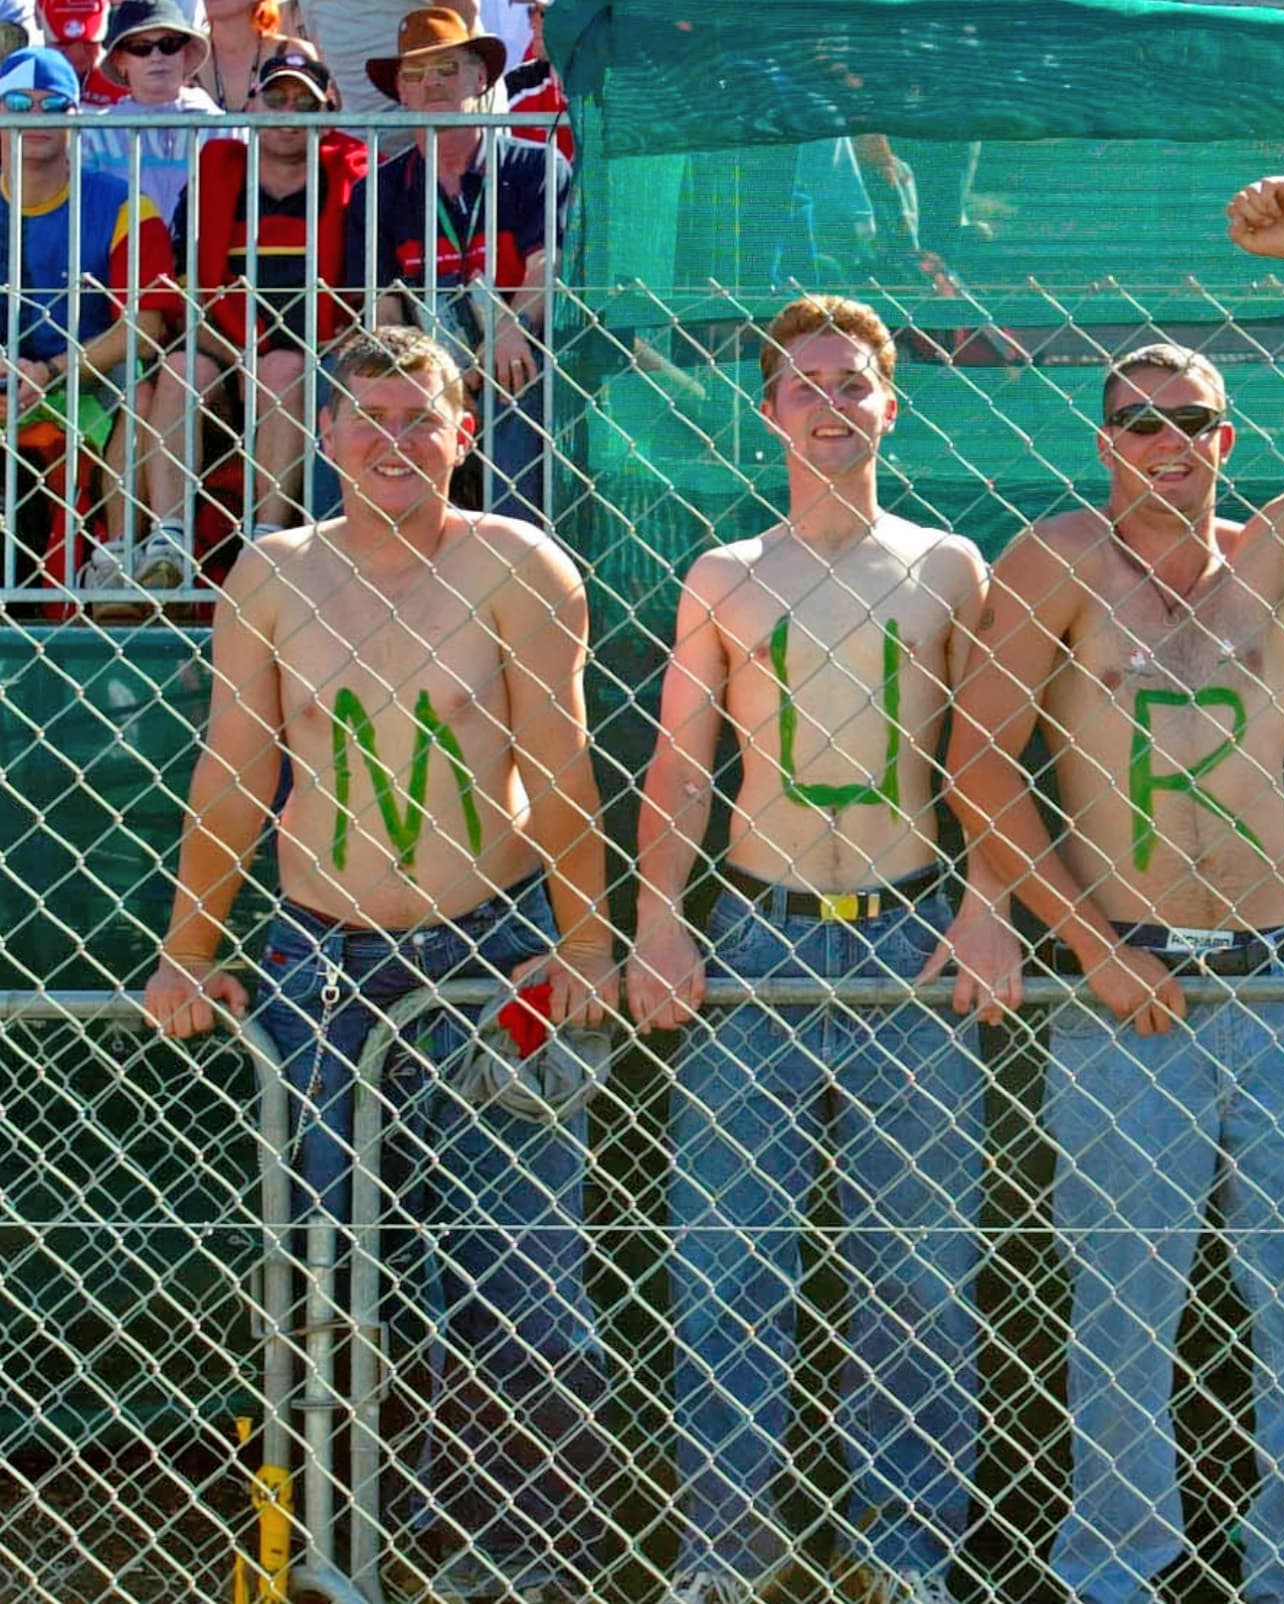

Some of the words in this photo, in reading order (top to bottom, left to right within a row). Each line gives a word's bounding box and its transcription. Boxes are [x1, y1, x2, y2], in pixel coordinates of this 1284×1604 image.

[333, 687, 482, 876] M
[770, 615, 901, 822] U
[1129, 686, 1264, 872] R
